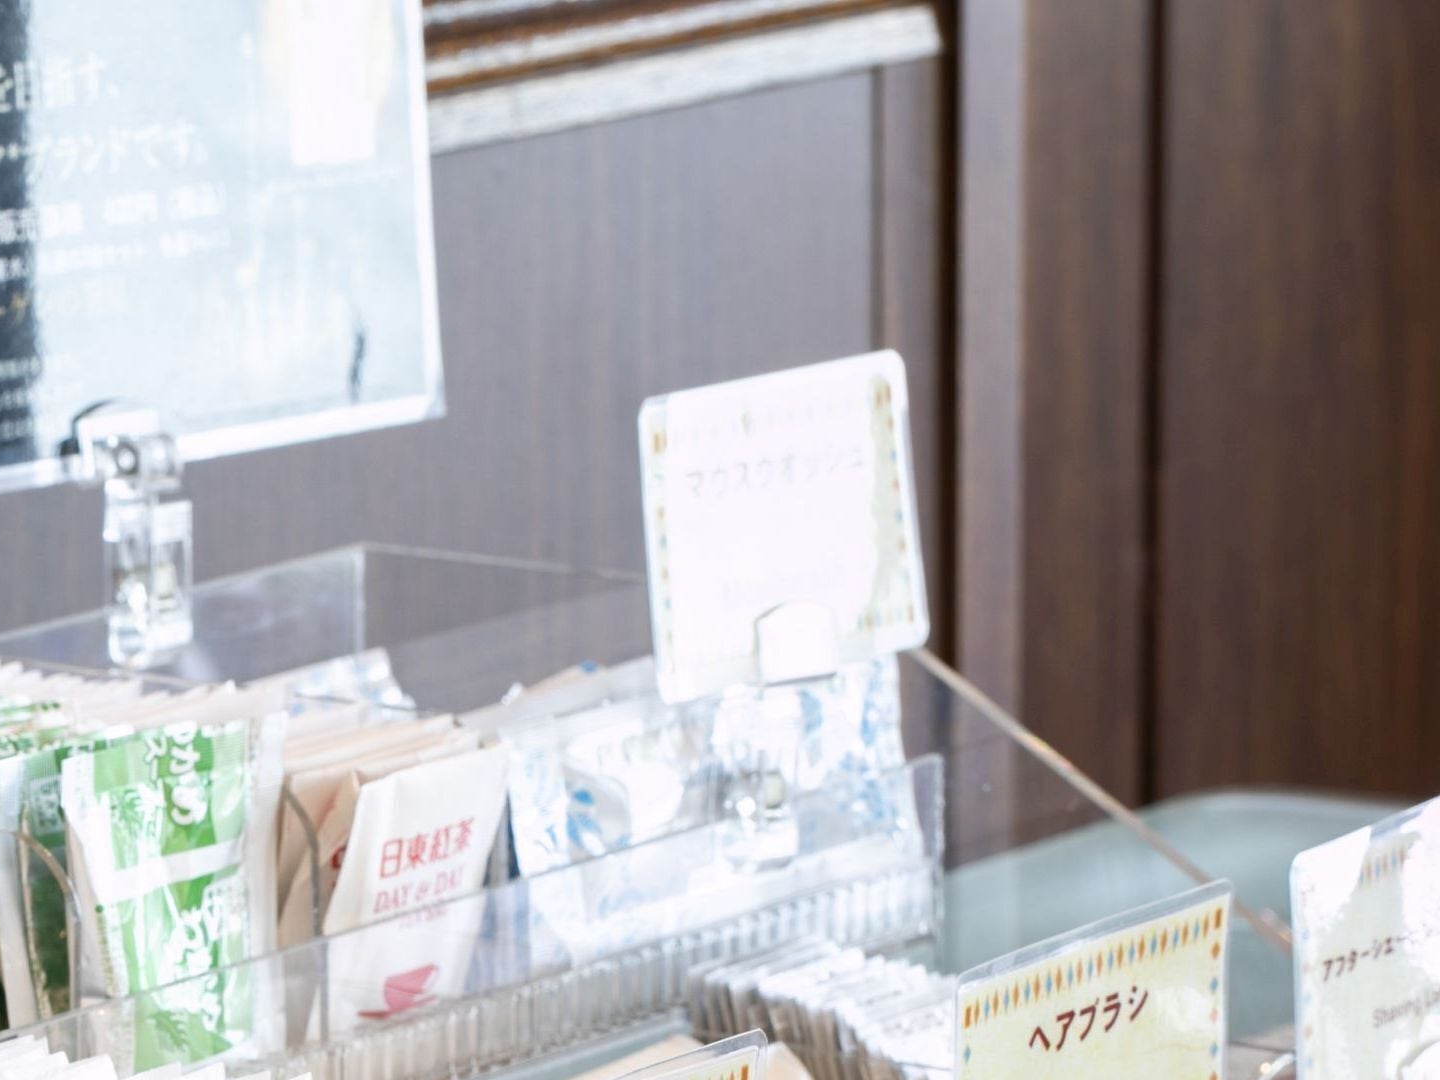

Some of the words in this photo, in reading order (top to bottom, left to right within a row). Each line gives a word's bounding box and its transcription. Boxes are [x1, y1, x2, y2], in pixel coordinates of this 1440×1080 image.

[1028, 984, 1149, 1052] ヘアブラシ
